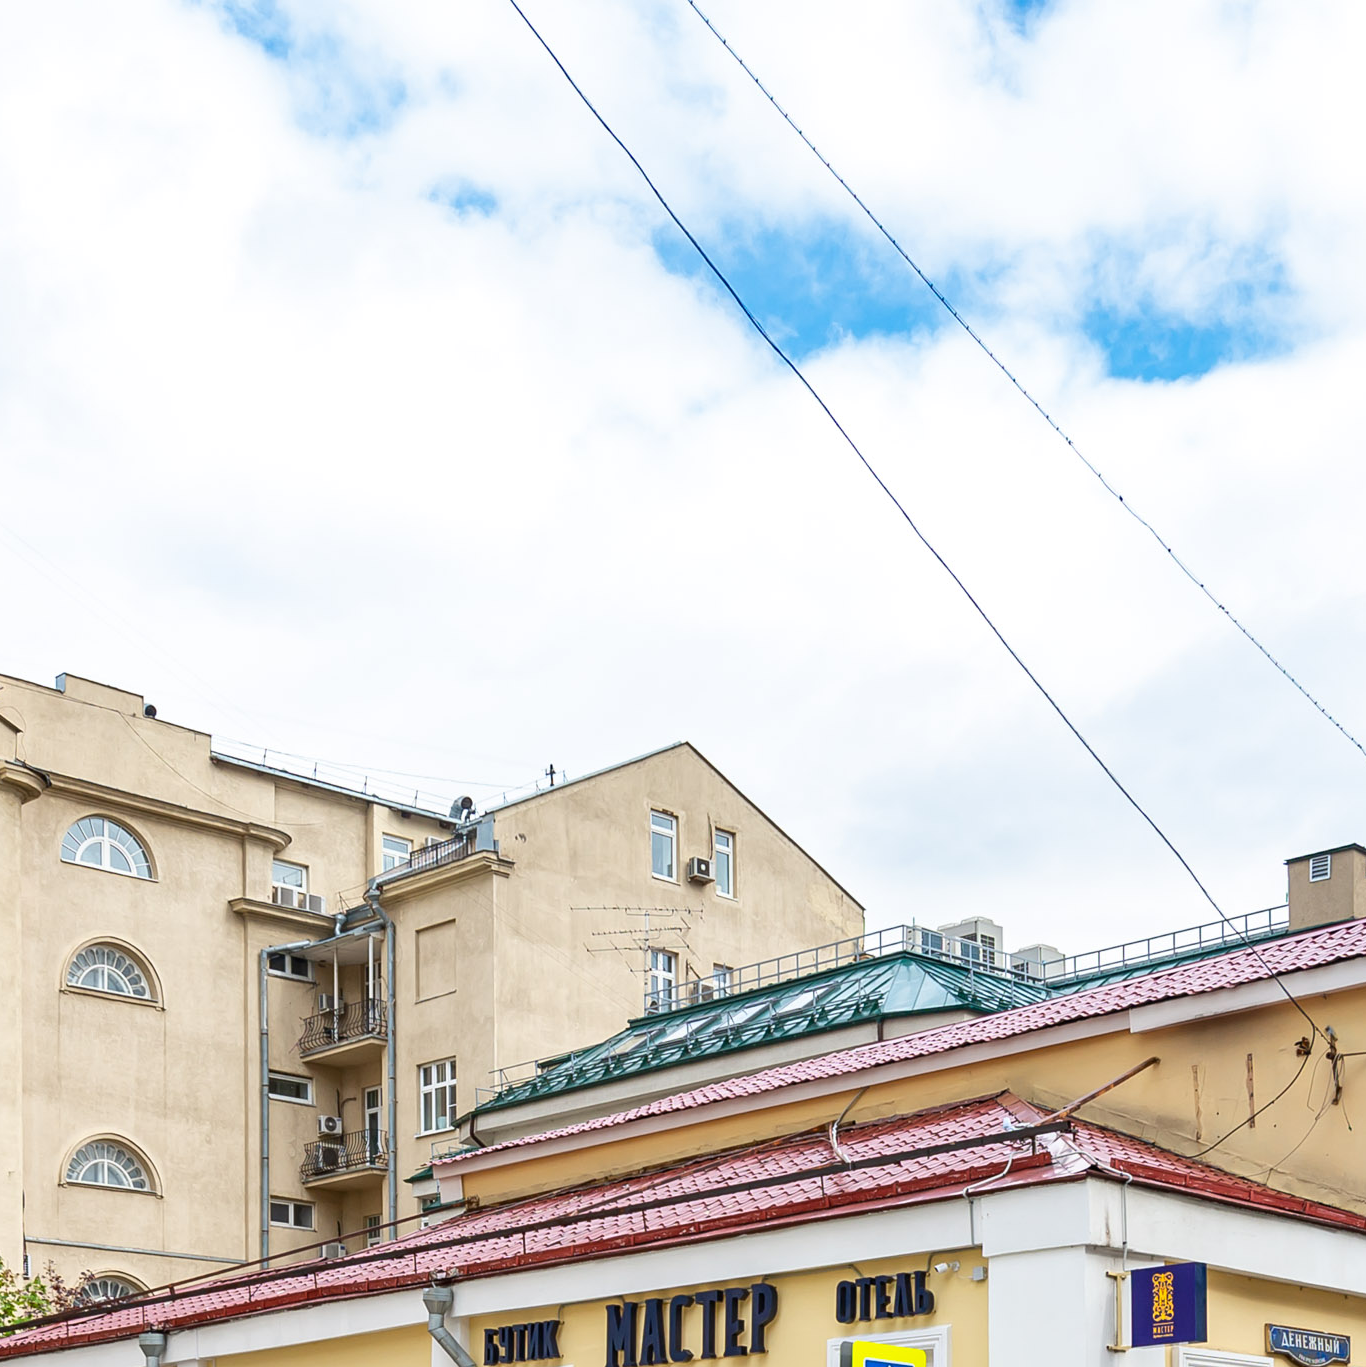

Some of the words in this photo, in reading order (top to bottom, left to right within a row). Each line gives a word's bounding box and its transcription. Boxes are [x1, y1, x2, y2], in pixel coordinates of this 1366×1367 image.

[484, 1319, 562, 1366] БУТИК
[836, 1270, 935, 1324] ОТЕЛЬ
[1281, 1331, 1340, 1354] ДЕНЕЖНЫЙ
